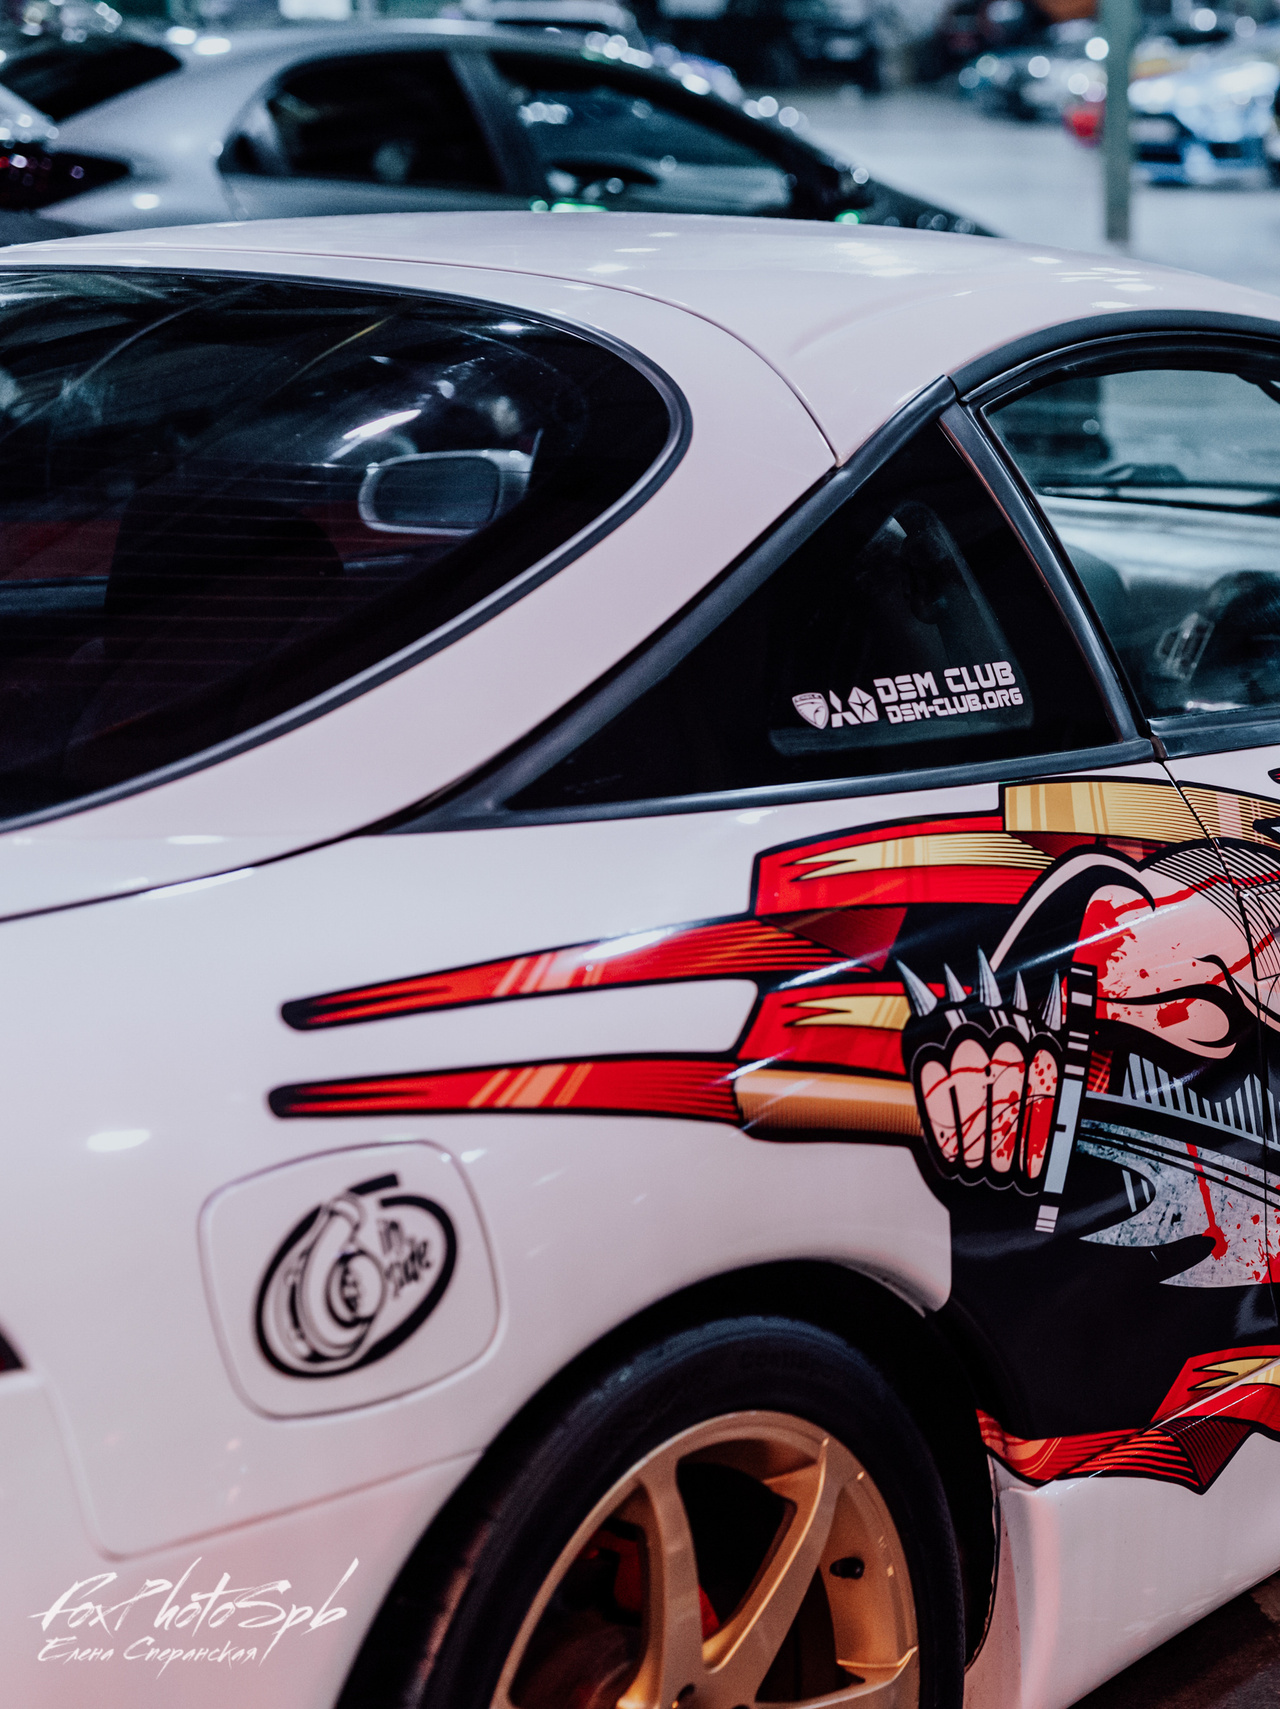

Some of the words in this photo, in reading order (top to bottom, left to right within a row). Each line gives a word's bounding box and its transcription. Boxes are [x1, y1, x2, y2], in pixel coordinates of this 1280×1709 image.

[873, 671, 939, 704] DSM
[944, 661, 1015, 693] CLUB
[885, 687, 1023, 724] DSM-CLUB.ORG
